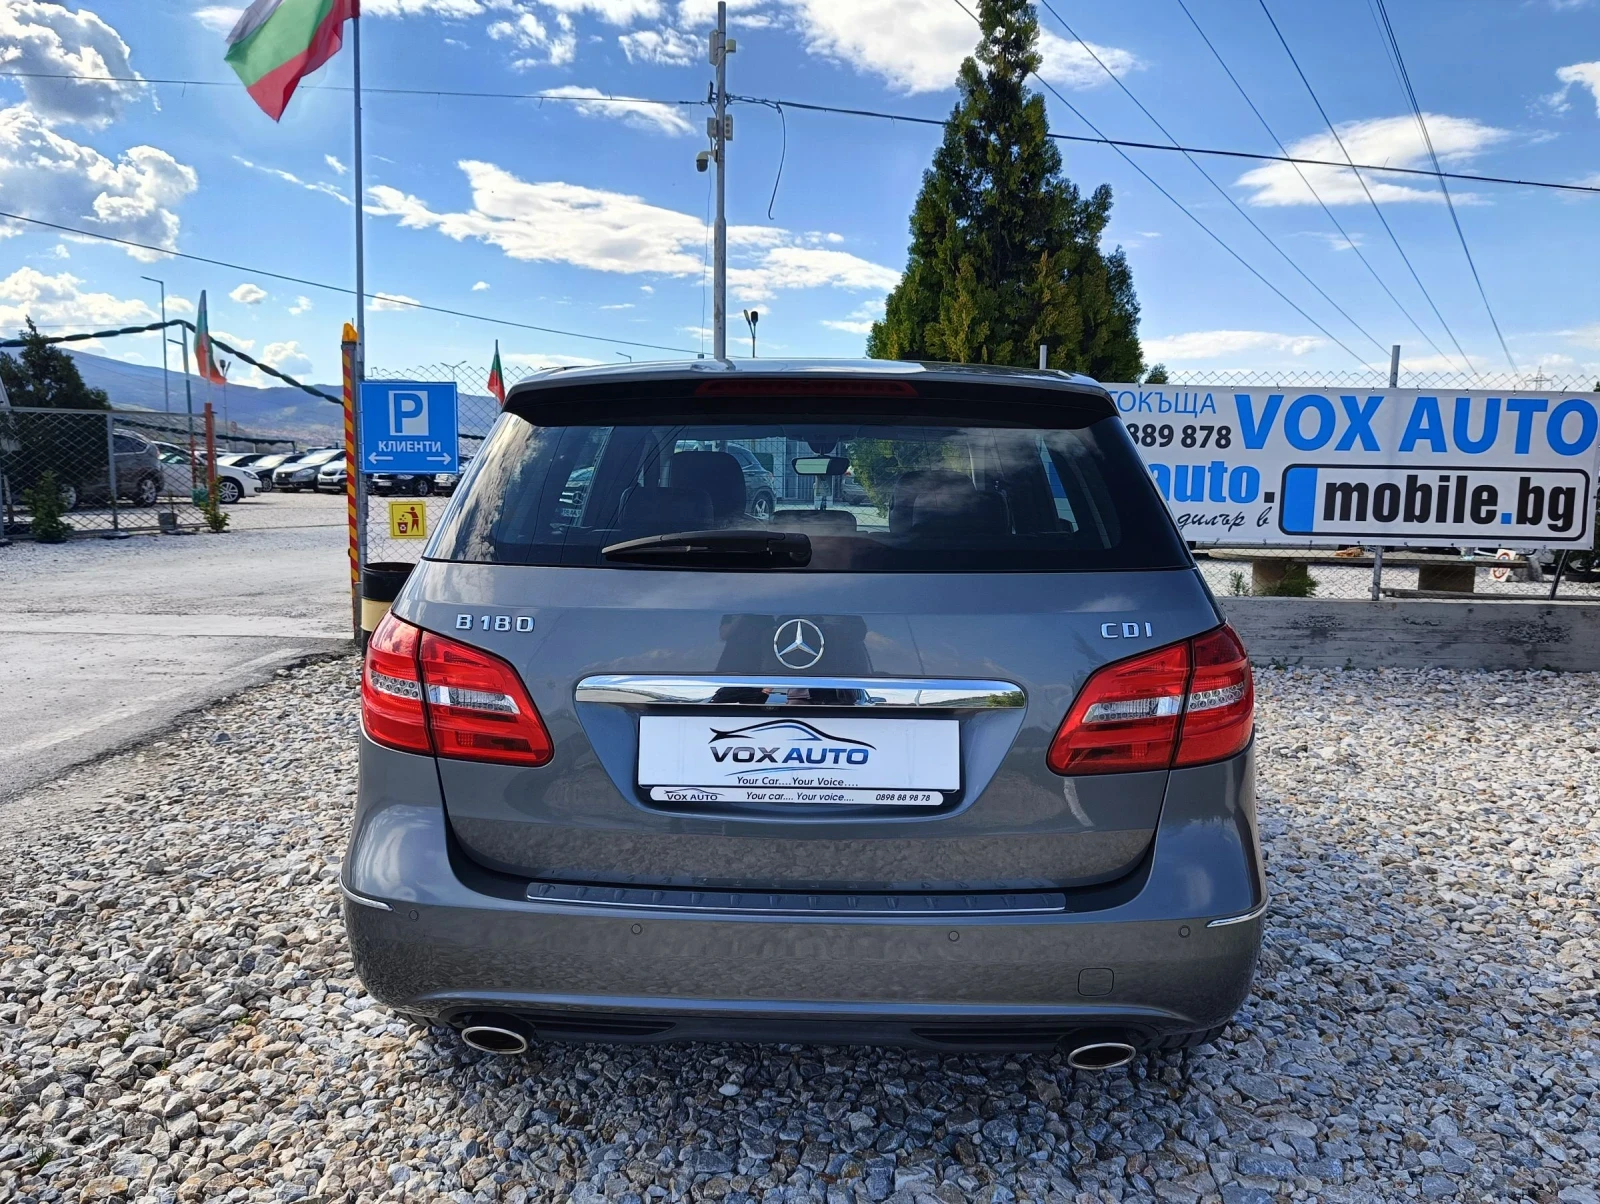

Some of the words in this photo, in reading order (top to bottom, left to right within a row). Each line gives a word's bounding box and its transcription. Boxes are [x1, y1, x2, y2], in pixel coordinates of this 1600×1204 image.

[1233, 394, 1385, 452] VOX
[1398, 396, 1598, 456] AUTO
[1181, 424, 1232, 449] 878
[378, 440, 442, 453] КЛИЕНТИ
[1322, 474, 1577, 532] mobile.bg
[455, 614, 474, 631] B
[480, 615, 536, 633] 180
[1100, 621, 1154, 640] CDI
[737, 776, 759, 786] Your
[746, 791, 766, 800] Your
[796, 792, 816, 801] Your
[875, 793, 896, 801] 0898
[897, 793, 907, 801] 88
[909, 794, 919, 802] 98
[920, 794, 931, 802] 78
